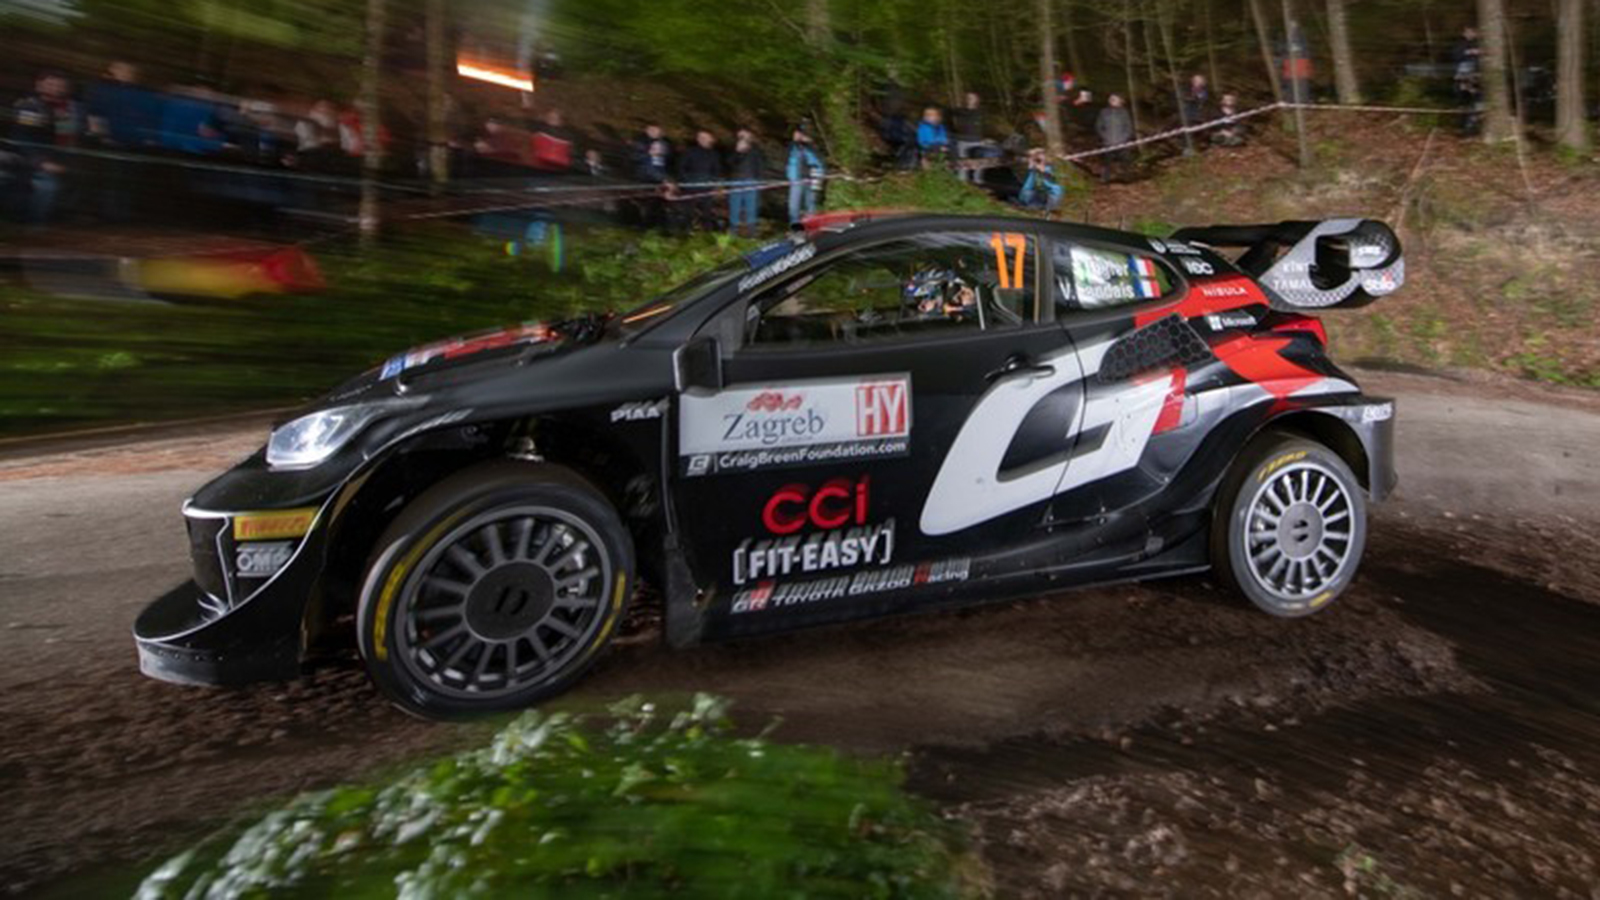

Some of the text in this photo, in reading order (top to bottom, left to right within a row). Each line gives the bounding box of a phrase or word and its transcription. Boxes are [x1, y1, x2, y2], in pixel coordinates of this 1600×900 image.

[991, 232, 1026, 288] 17
[611, 406, 660, 422] PIAA
[722, 408, 824, 445] Zagreb
[857, 385, 905, 436] HY
[719, 442, 907, 469] CraigBreenFoundation.com
